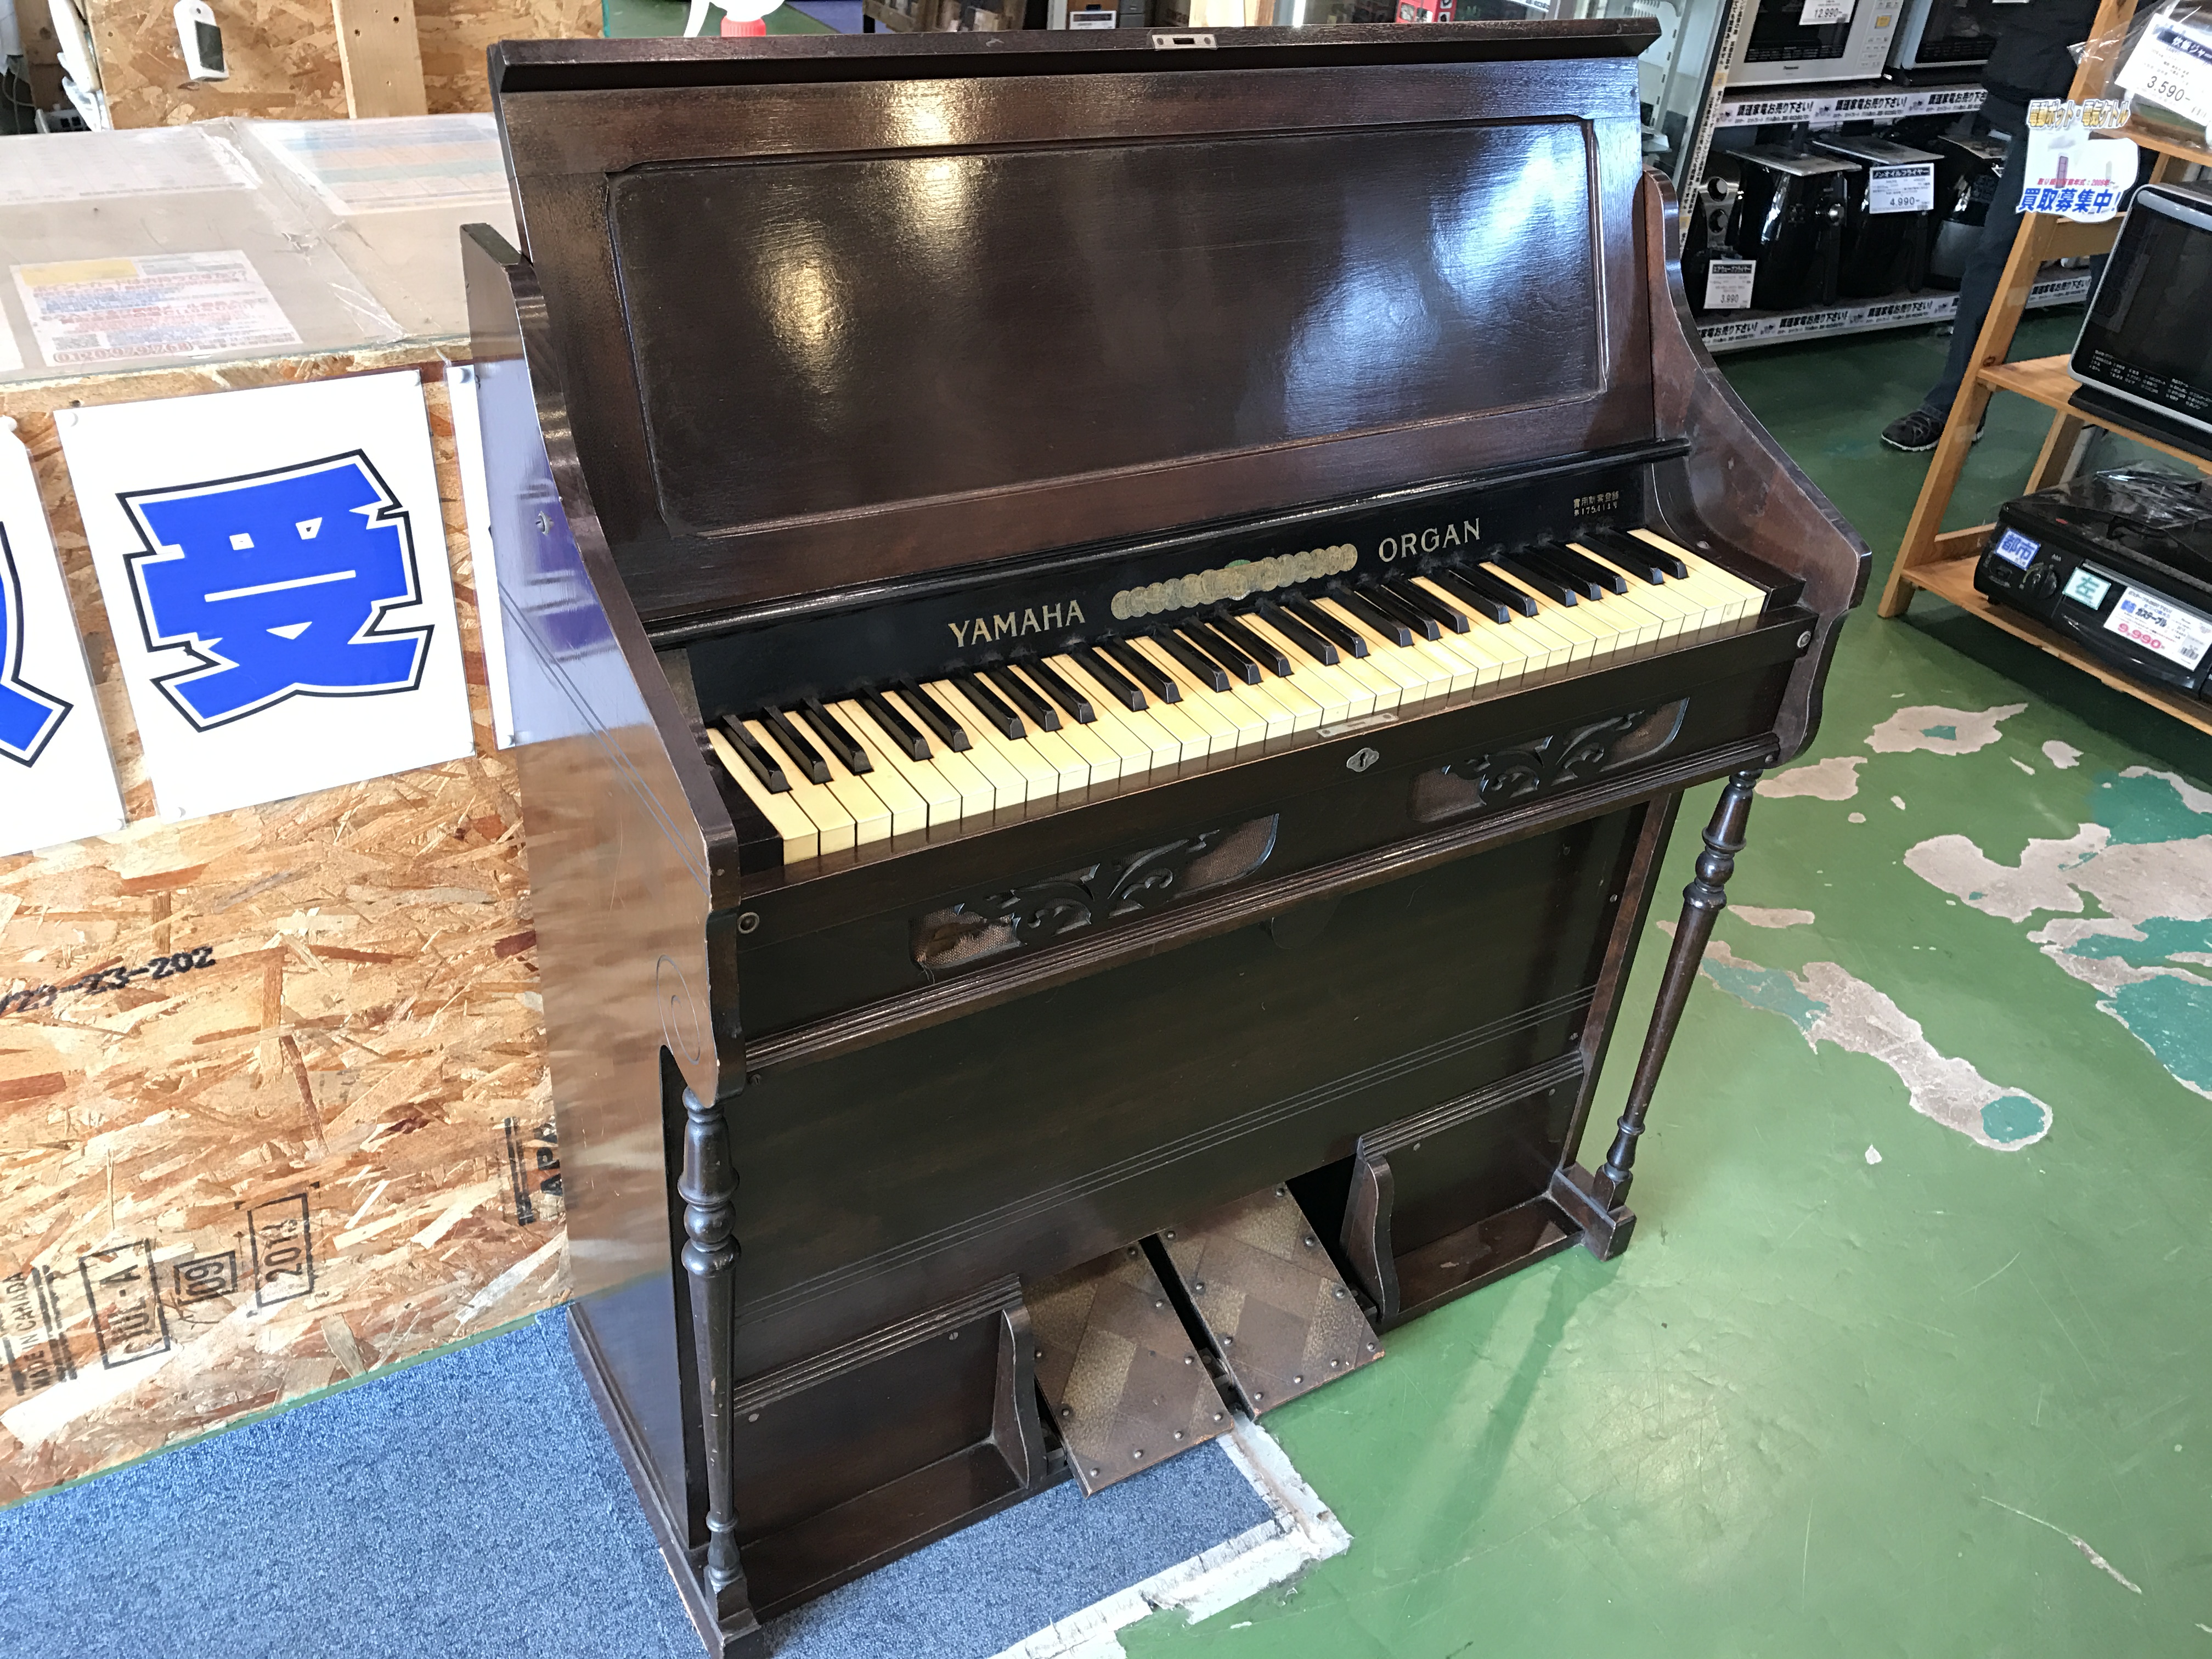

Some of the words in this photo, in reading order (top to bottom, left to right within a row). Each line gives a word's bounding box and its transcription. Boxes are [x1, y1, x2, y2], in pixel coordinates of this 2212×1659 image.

[2001, 534, 2032, 560] 都市
[947, 599, 1086, 648] YAMAHA
[1379, 517, 1480, 562] ORGAN
[2075, 577, 2100, 600] 左
[2135, 607, 2167, 628] ガステーブル
[2, 1272, 37, 1331] CANADA
[19, 1333, 40, 1350] IN
